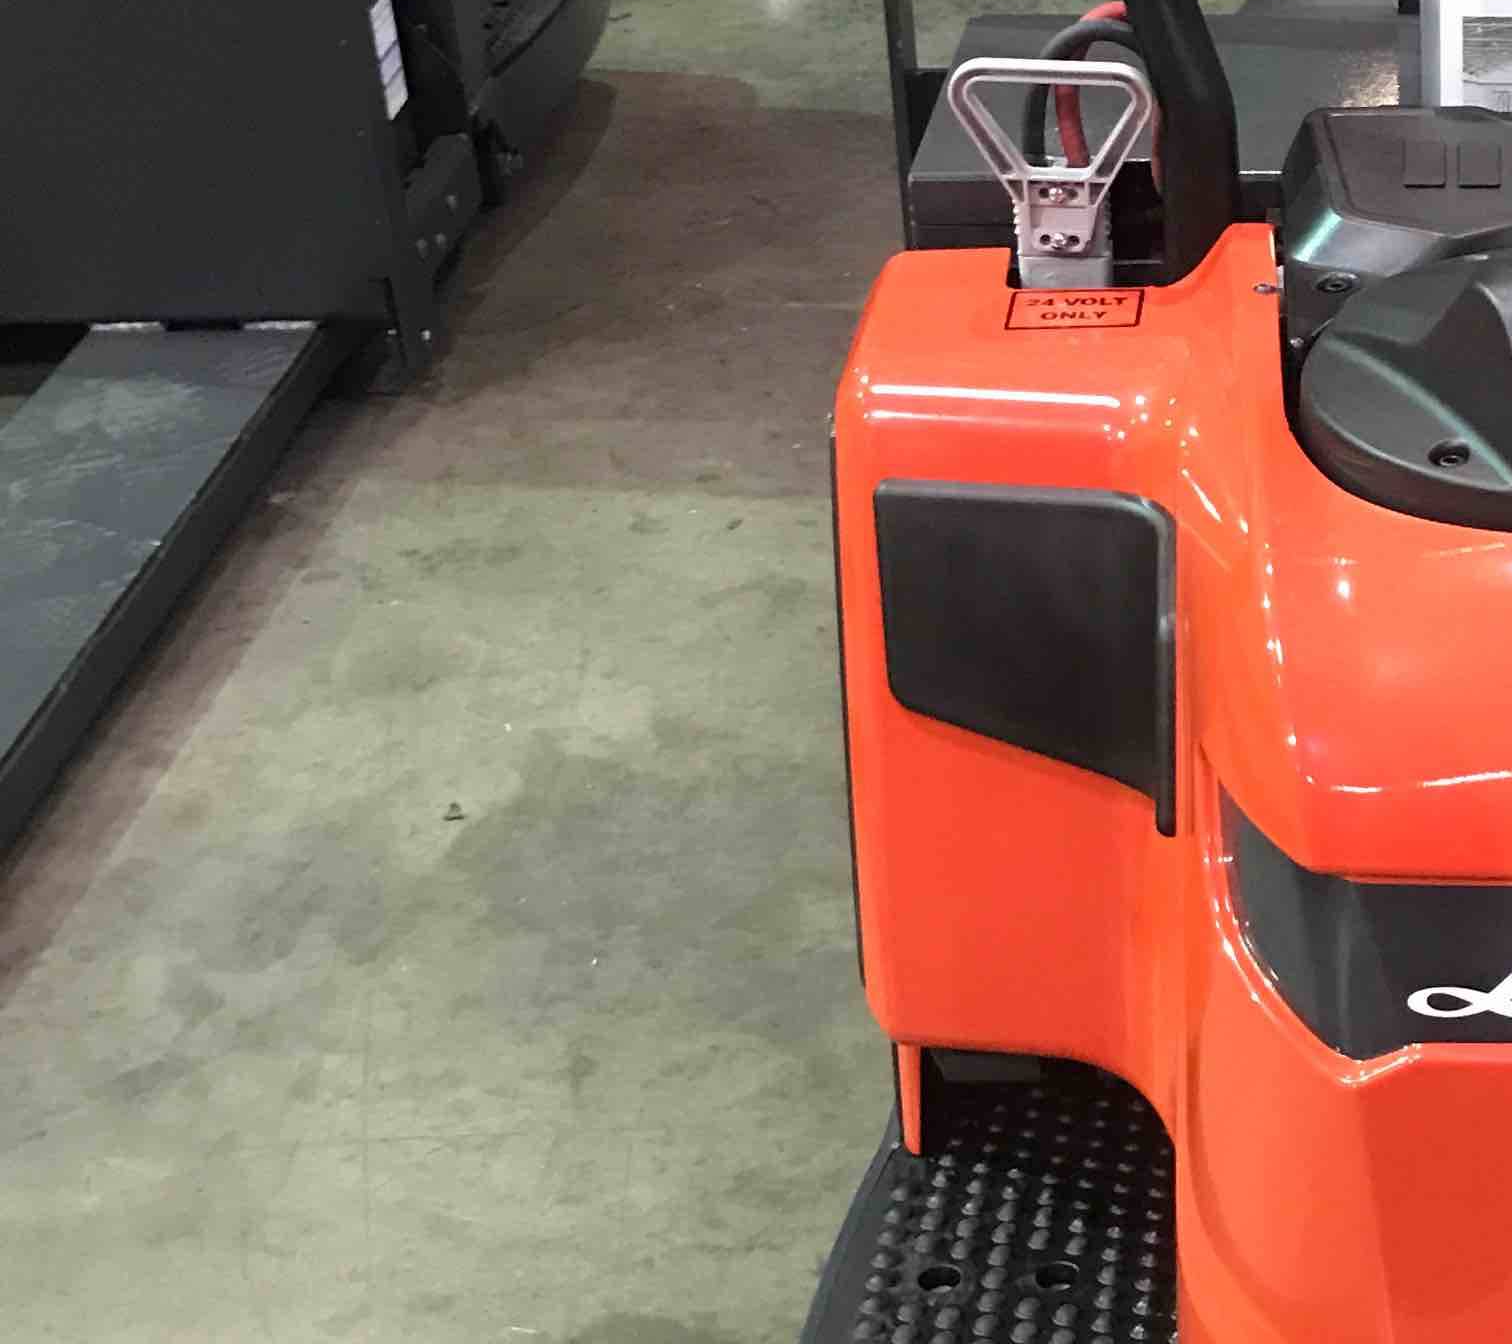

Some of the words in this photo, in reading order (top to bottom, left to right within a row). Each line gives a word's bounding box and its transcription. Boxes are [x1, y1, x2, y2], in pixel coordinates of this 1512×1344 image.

[1026, 297, 1055, 306] 24
[1064, 296, 1128, 306] VOLT
[1040, 311, 1107, 320] ONLY
